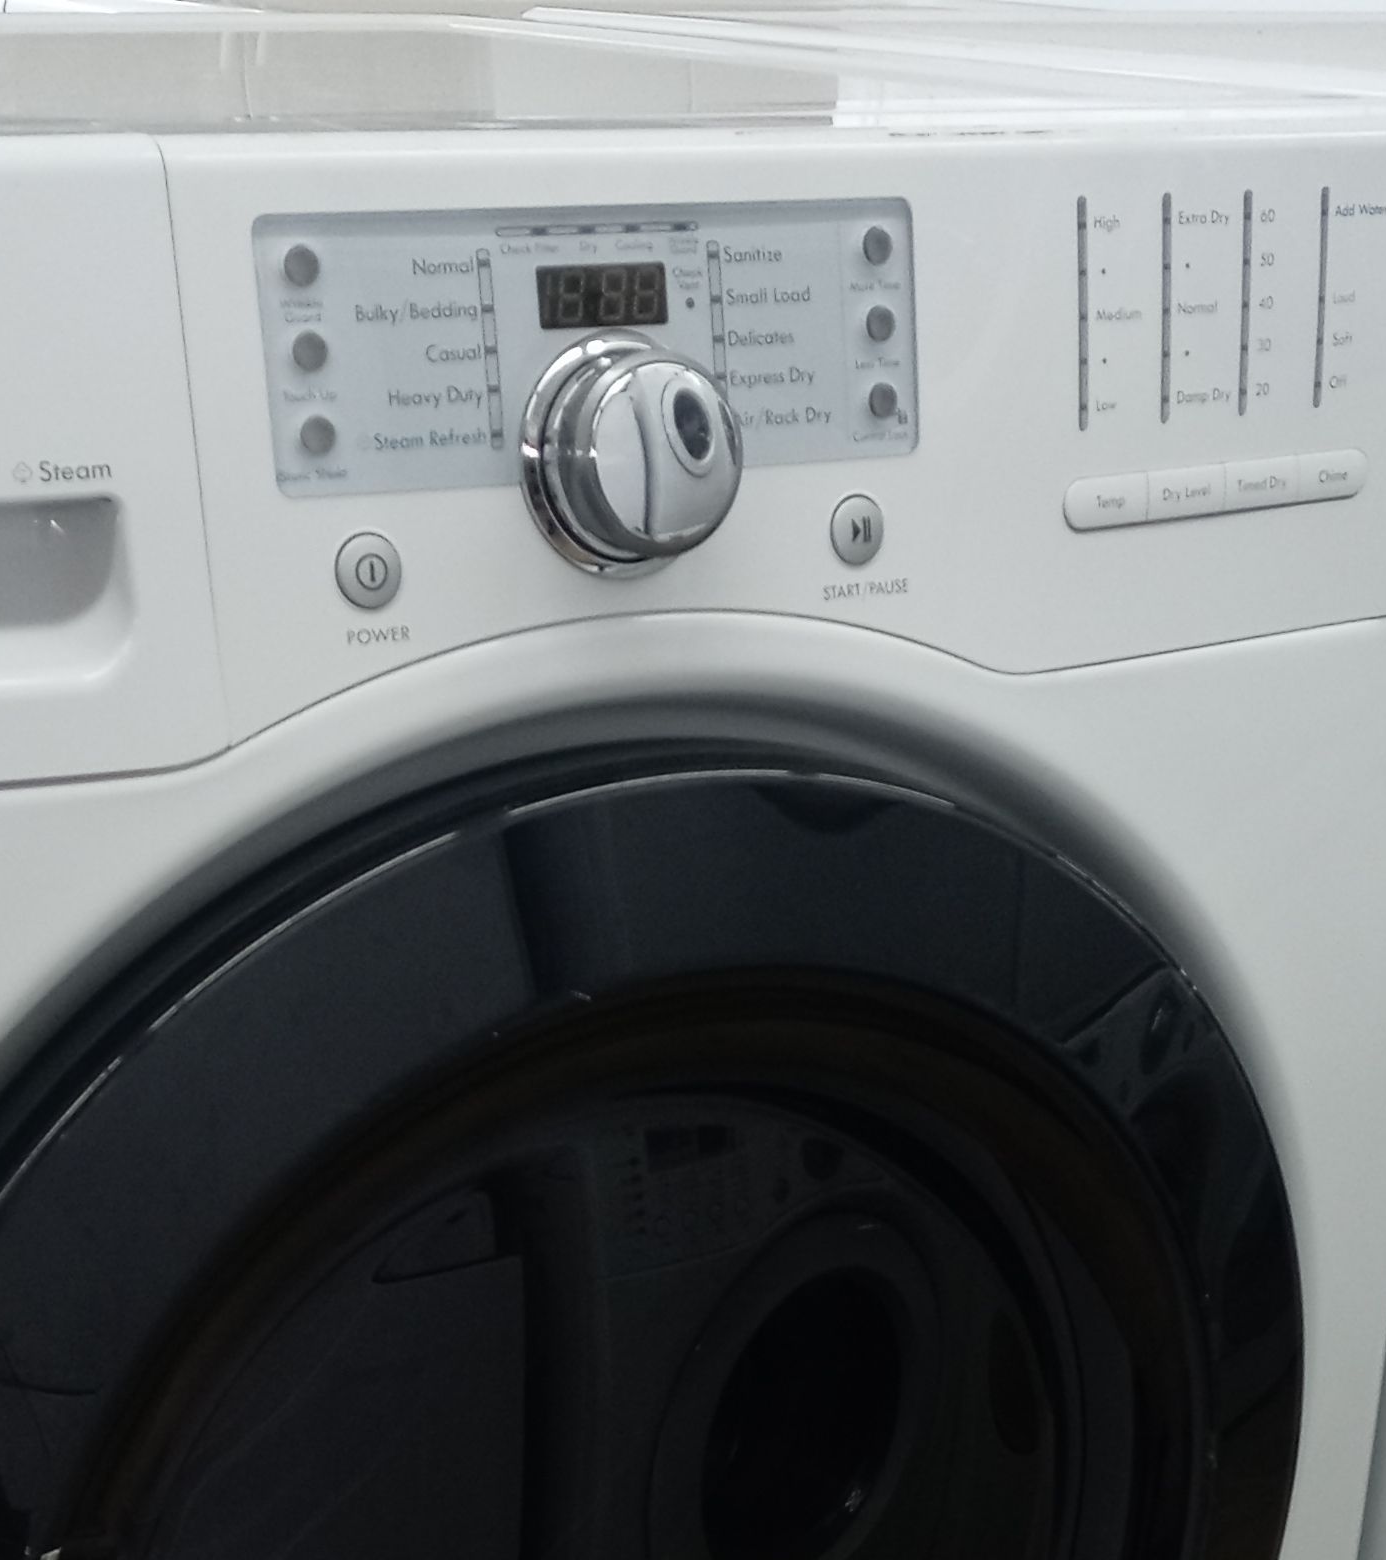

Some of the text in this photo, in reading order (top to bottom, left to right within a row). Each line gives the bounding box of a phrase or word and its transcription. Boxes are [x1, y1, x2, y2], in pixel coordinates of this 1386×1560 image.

[1178, 209, 1230, 226] Extra Dry
[1260, 209, 1275, 223] 60
[1335, 204, 1386, 216] Add Water
[1094, 214, 1120, 231] High
[723, 246, 783, 263] Sanitize
[1260, 253, 1275, 267] 50
[413, 257, 474, 275] Normal
[726, 286, 811, 305] Small Load
[355, 300, 478, 325] Bulky/Bedding
[1096, 307, 1142, 321] Medium
[1177, 301, 1218, 316] Normal
[728, 330, 795, 346] Delicates
[426, 344, 481, 362] Casual
[730, 366, 815, 388] Express Dry
[389, 385, 482, 408] Heavy Duty
[1213, 389, 1231, 404] Dry
[1255, 382, 1269, 396] 20
[1096, 400, 1117, 412] Low
[805, 407, 832, 424] Dry
[374, 428, 486, 450] Steam Refresh
[39, 460, 112, 482] Steam
[822, 578, 909, 600] START/PAUSE
[346, 624, 410, 646] POWER
